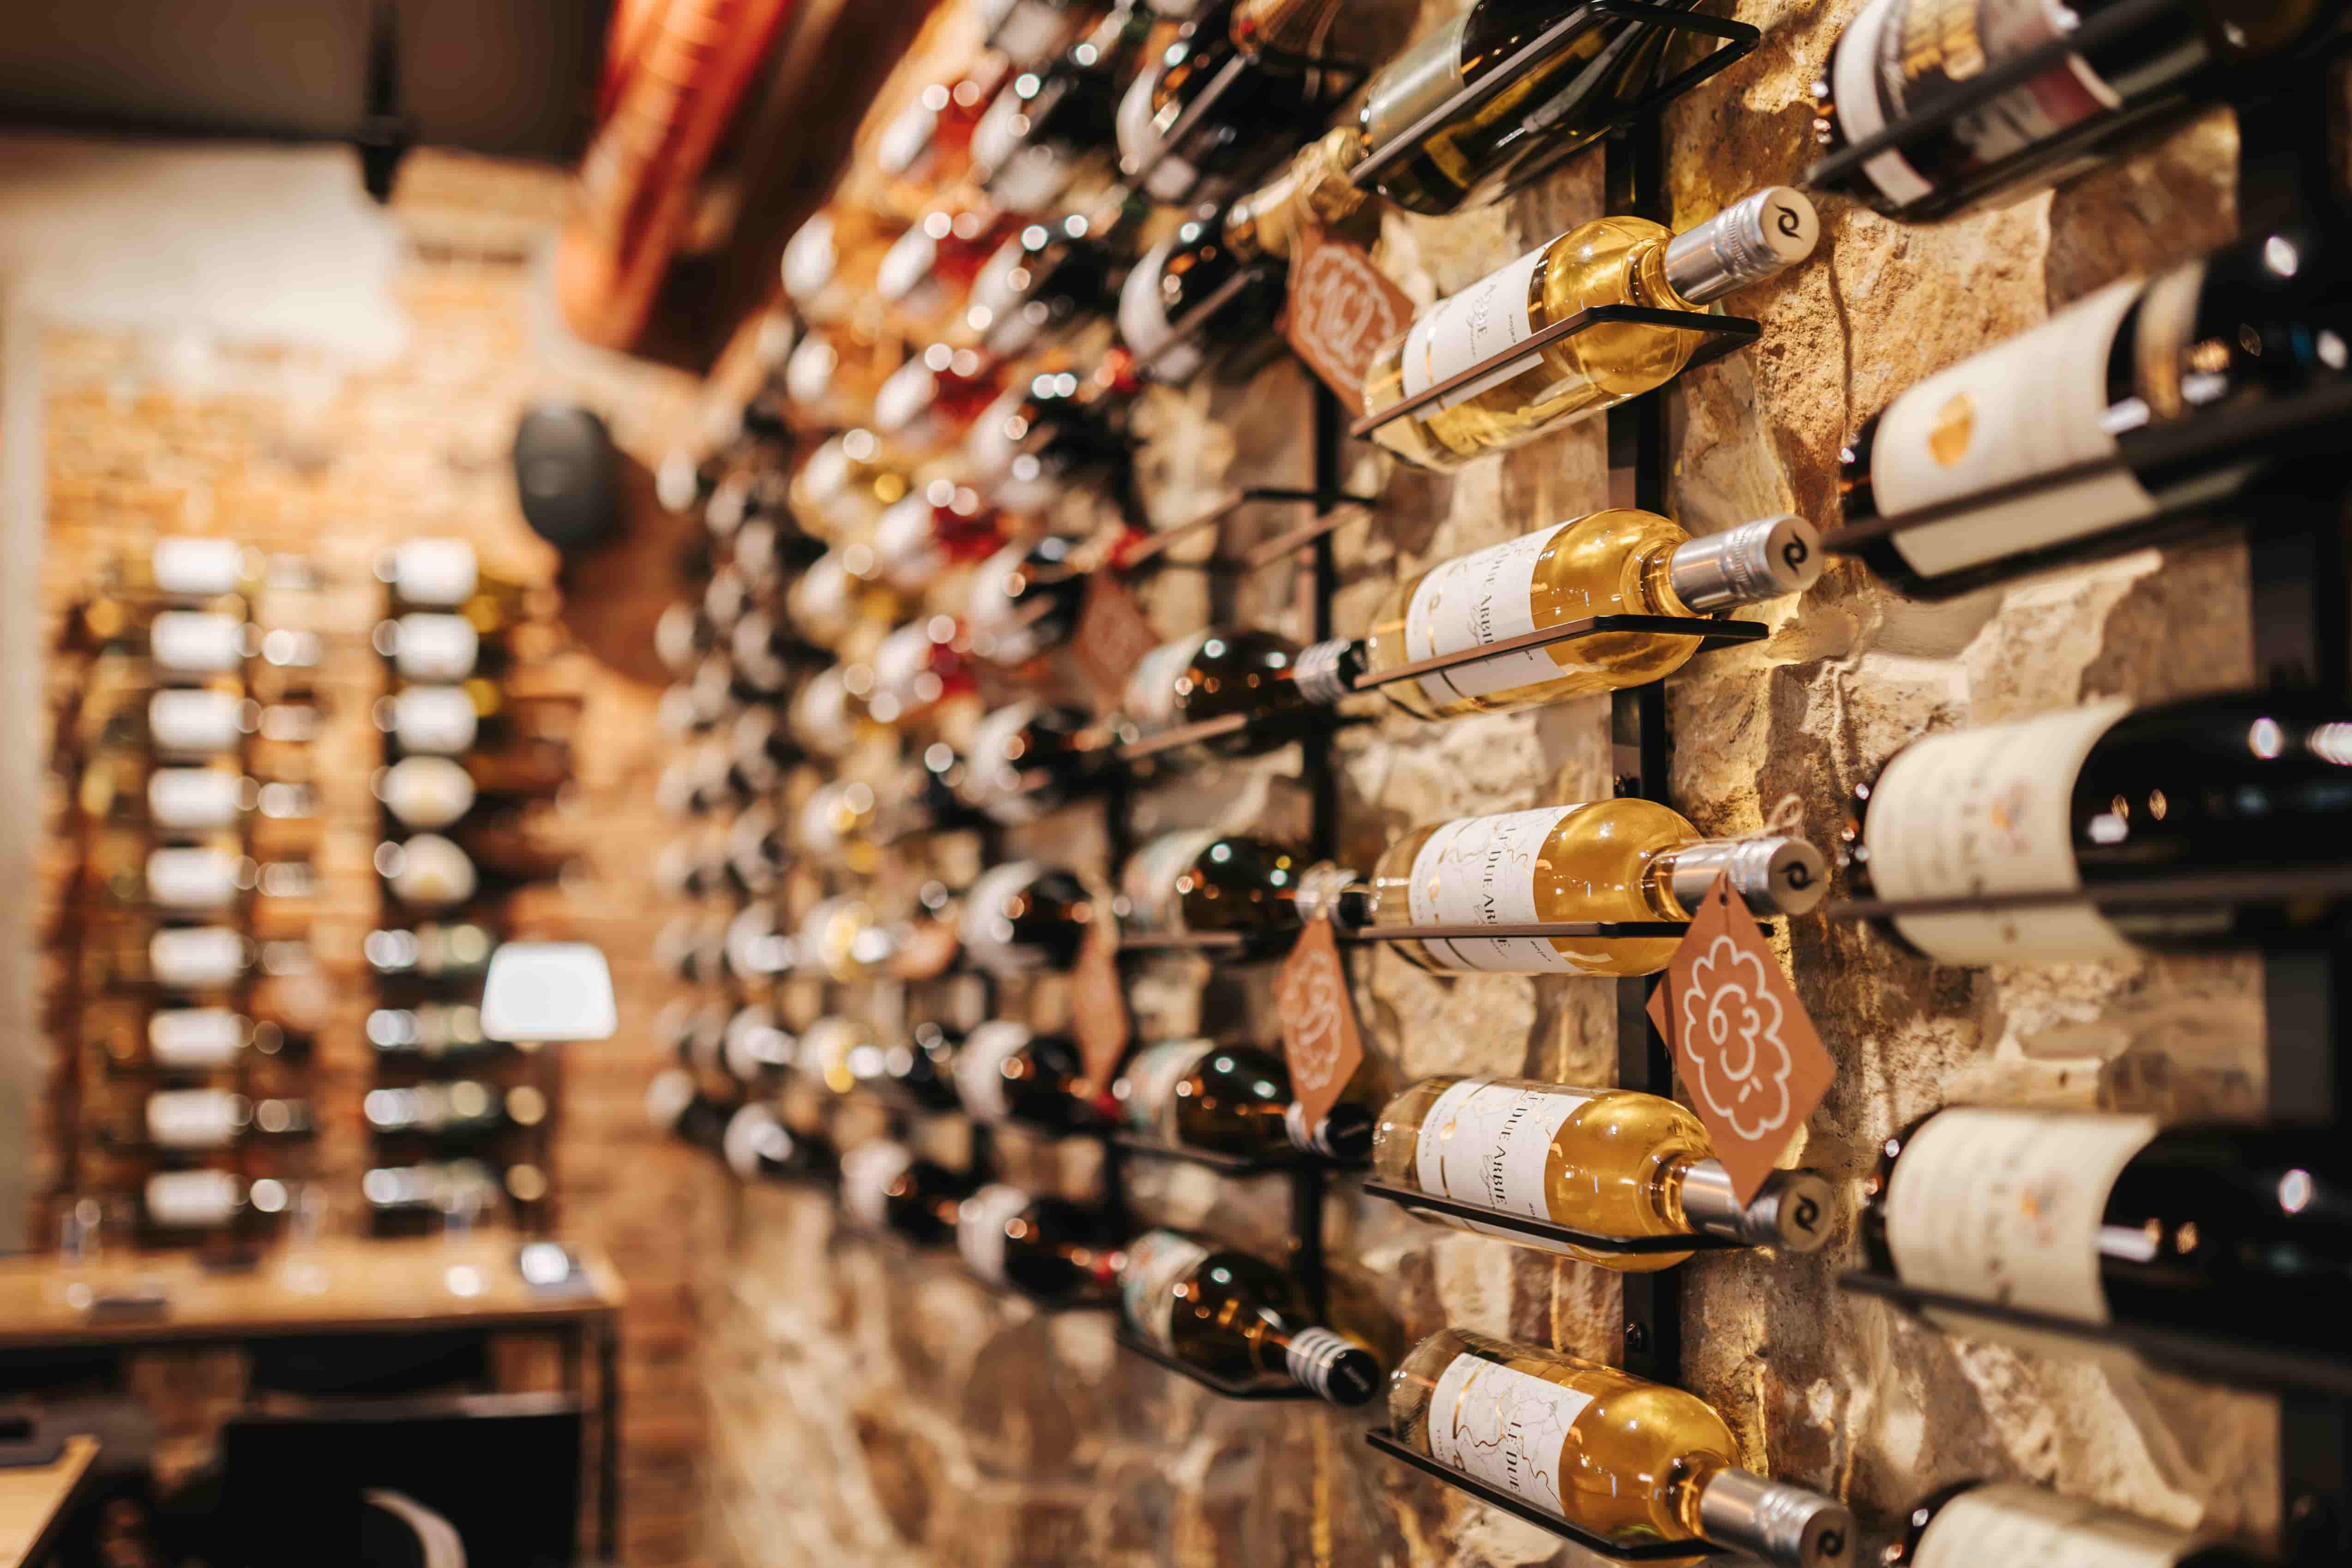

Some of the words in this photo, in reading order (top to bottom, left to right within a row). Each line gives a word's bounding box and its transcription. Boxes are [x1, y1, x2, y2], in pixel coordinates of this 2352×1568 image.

[1482, 851, 1502, 889] DUE
[1499, 1108, 1528, 1141] DUE
[1492, 1145, 1507, 1204] ARBIE
[1506, 1451, 1521, 1492] DUE
